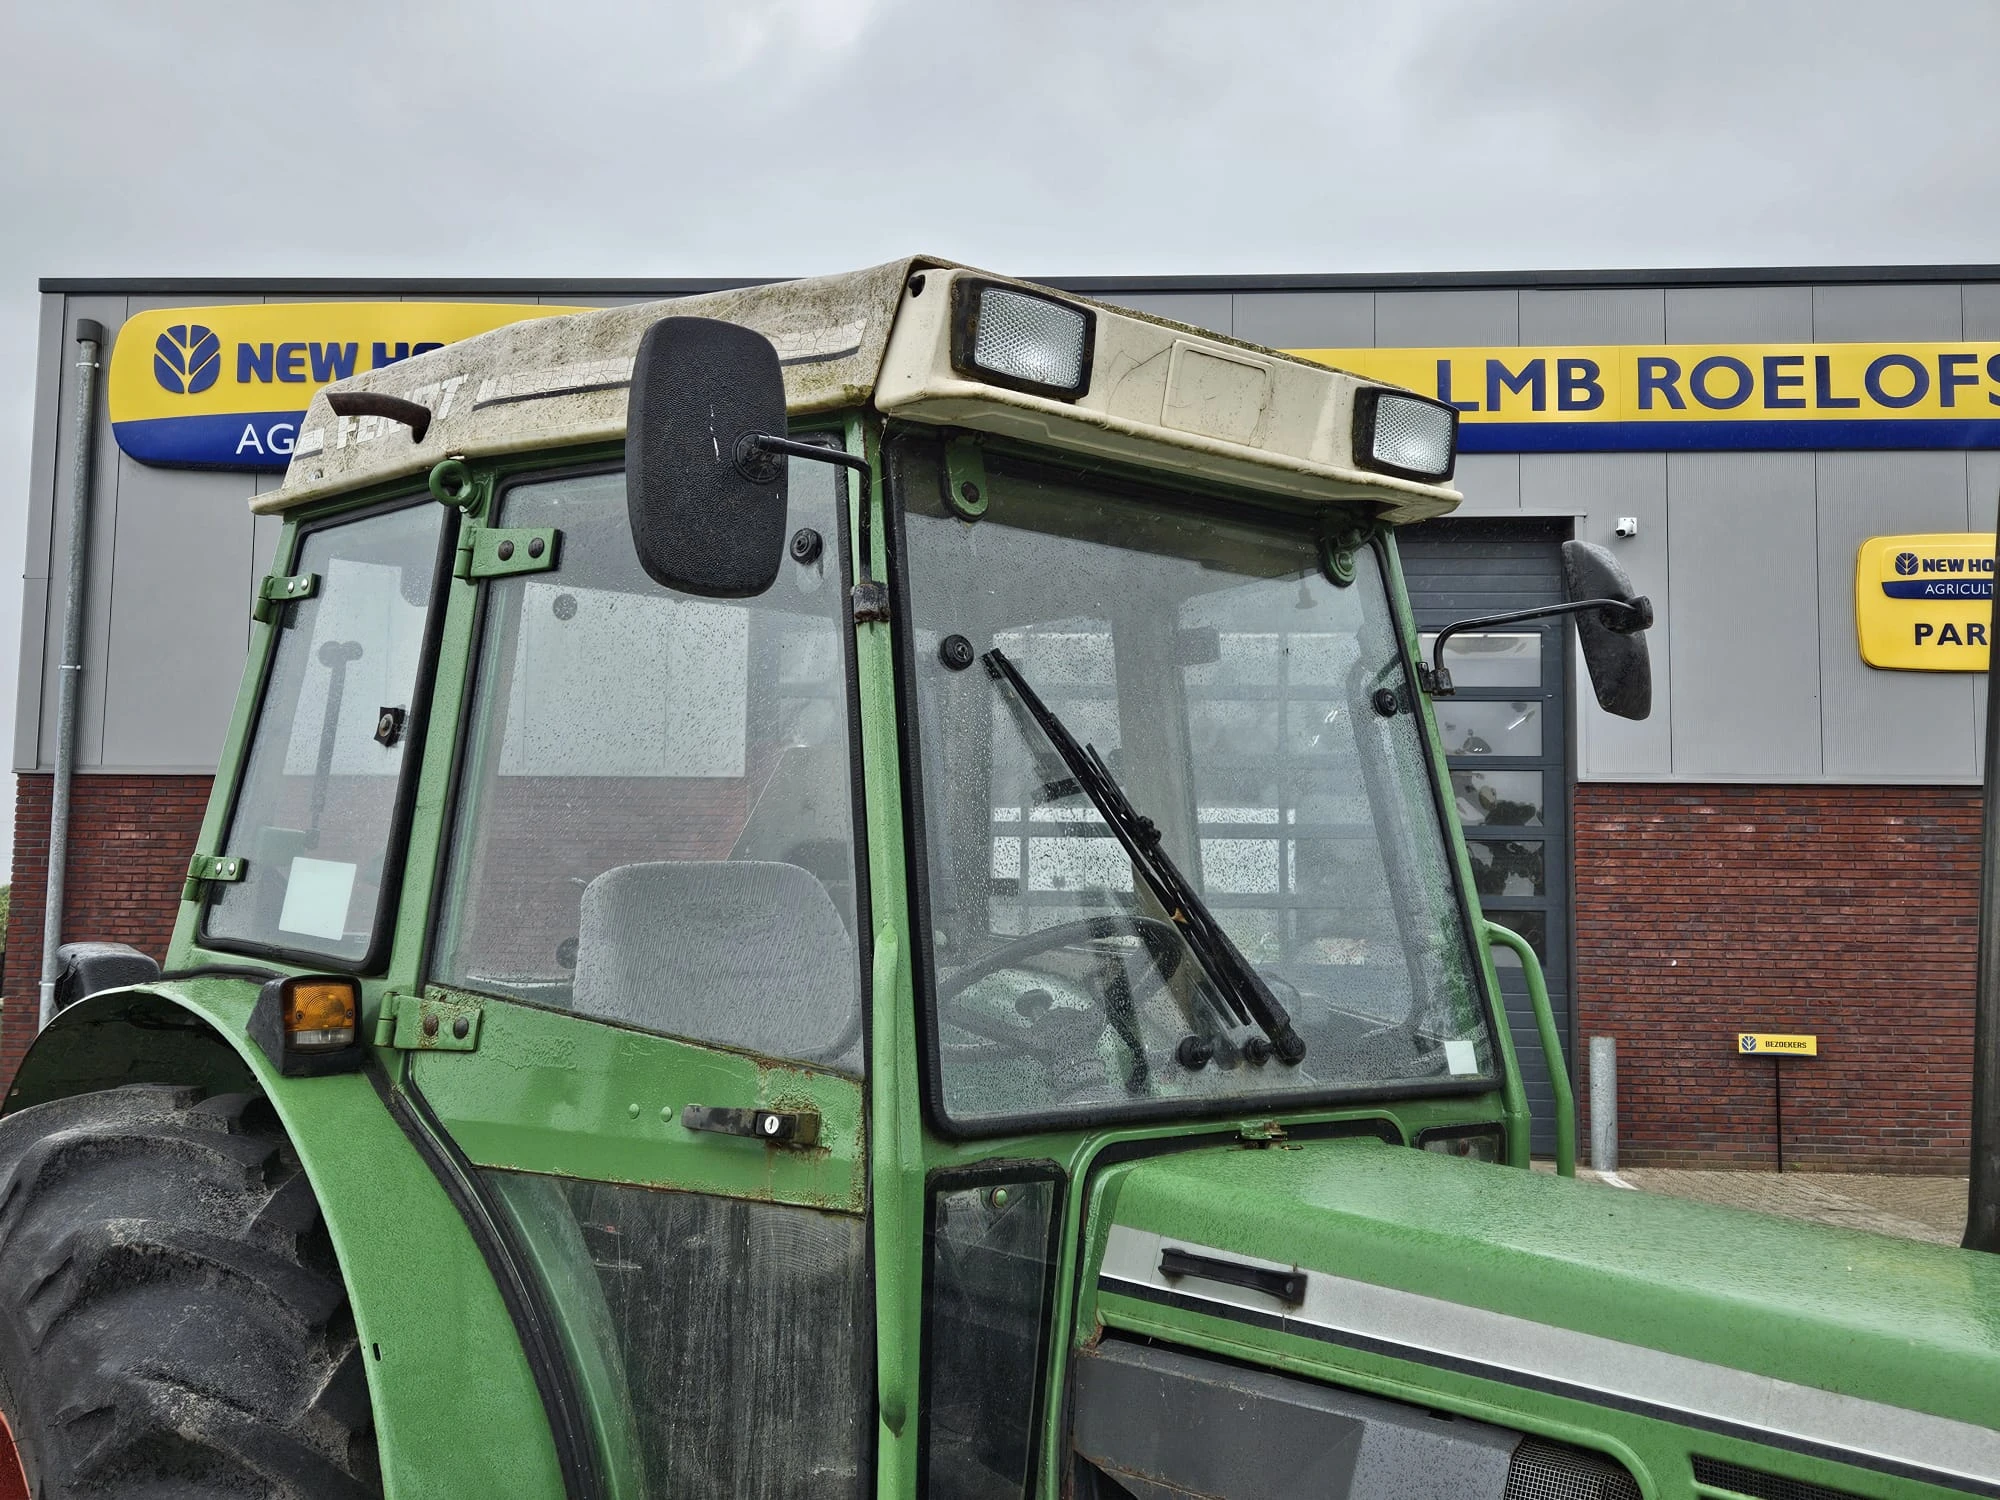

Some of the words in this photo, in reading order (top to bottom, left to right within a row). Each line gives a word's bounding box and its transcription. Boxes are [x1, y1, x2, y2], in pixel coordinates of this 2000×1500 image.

[236, 342, 358, 383] NEW
[1437, 358, 1605, 412] LMB
[1923, 559, 1964, 572] NEW
[1914, 623, 1988, 646] PAR
[1765, 1040, 1807, 1049] BEZOEKERS
